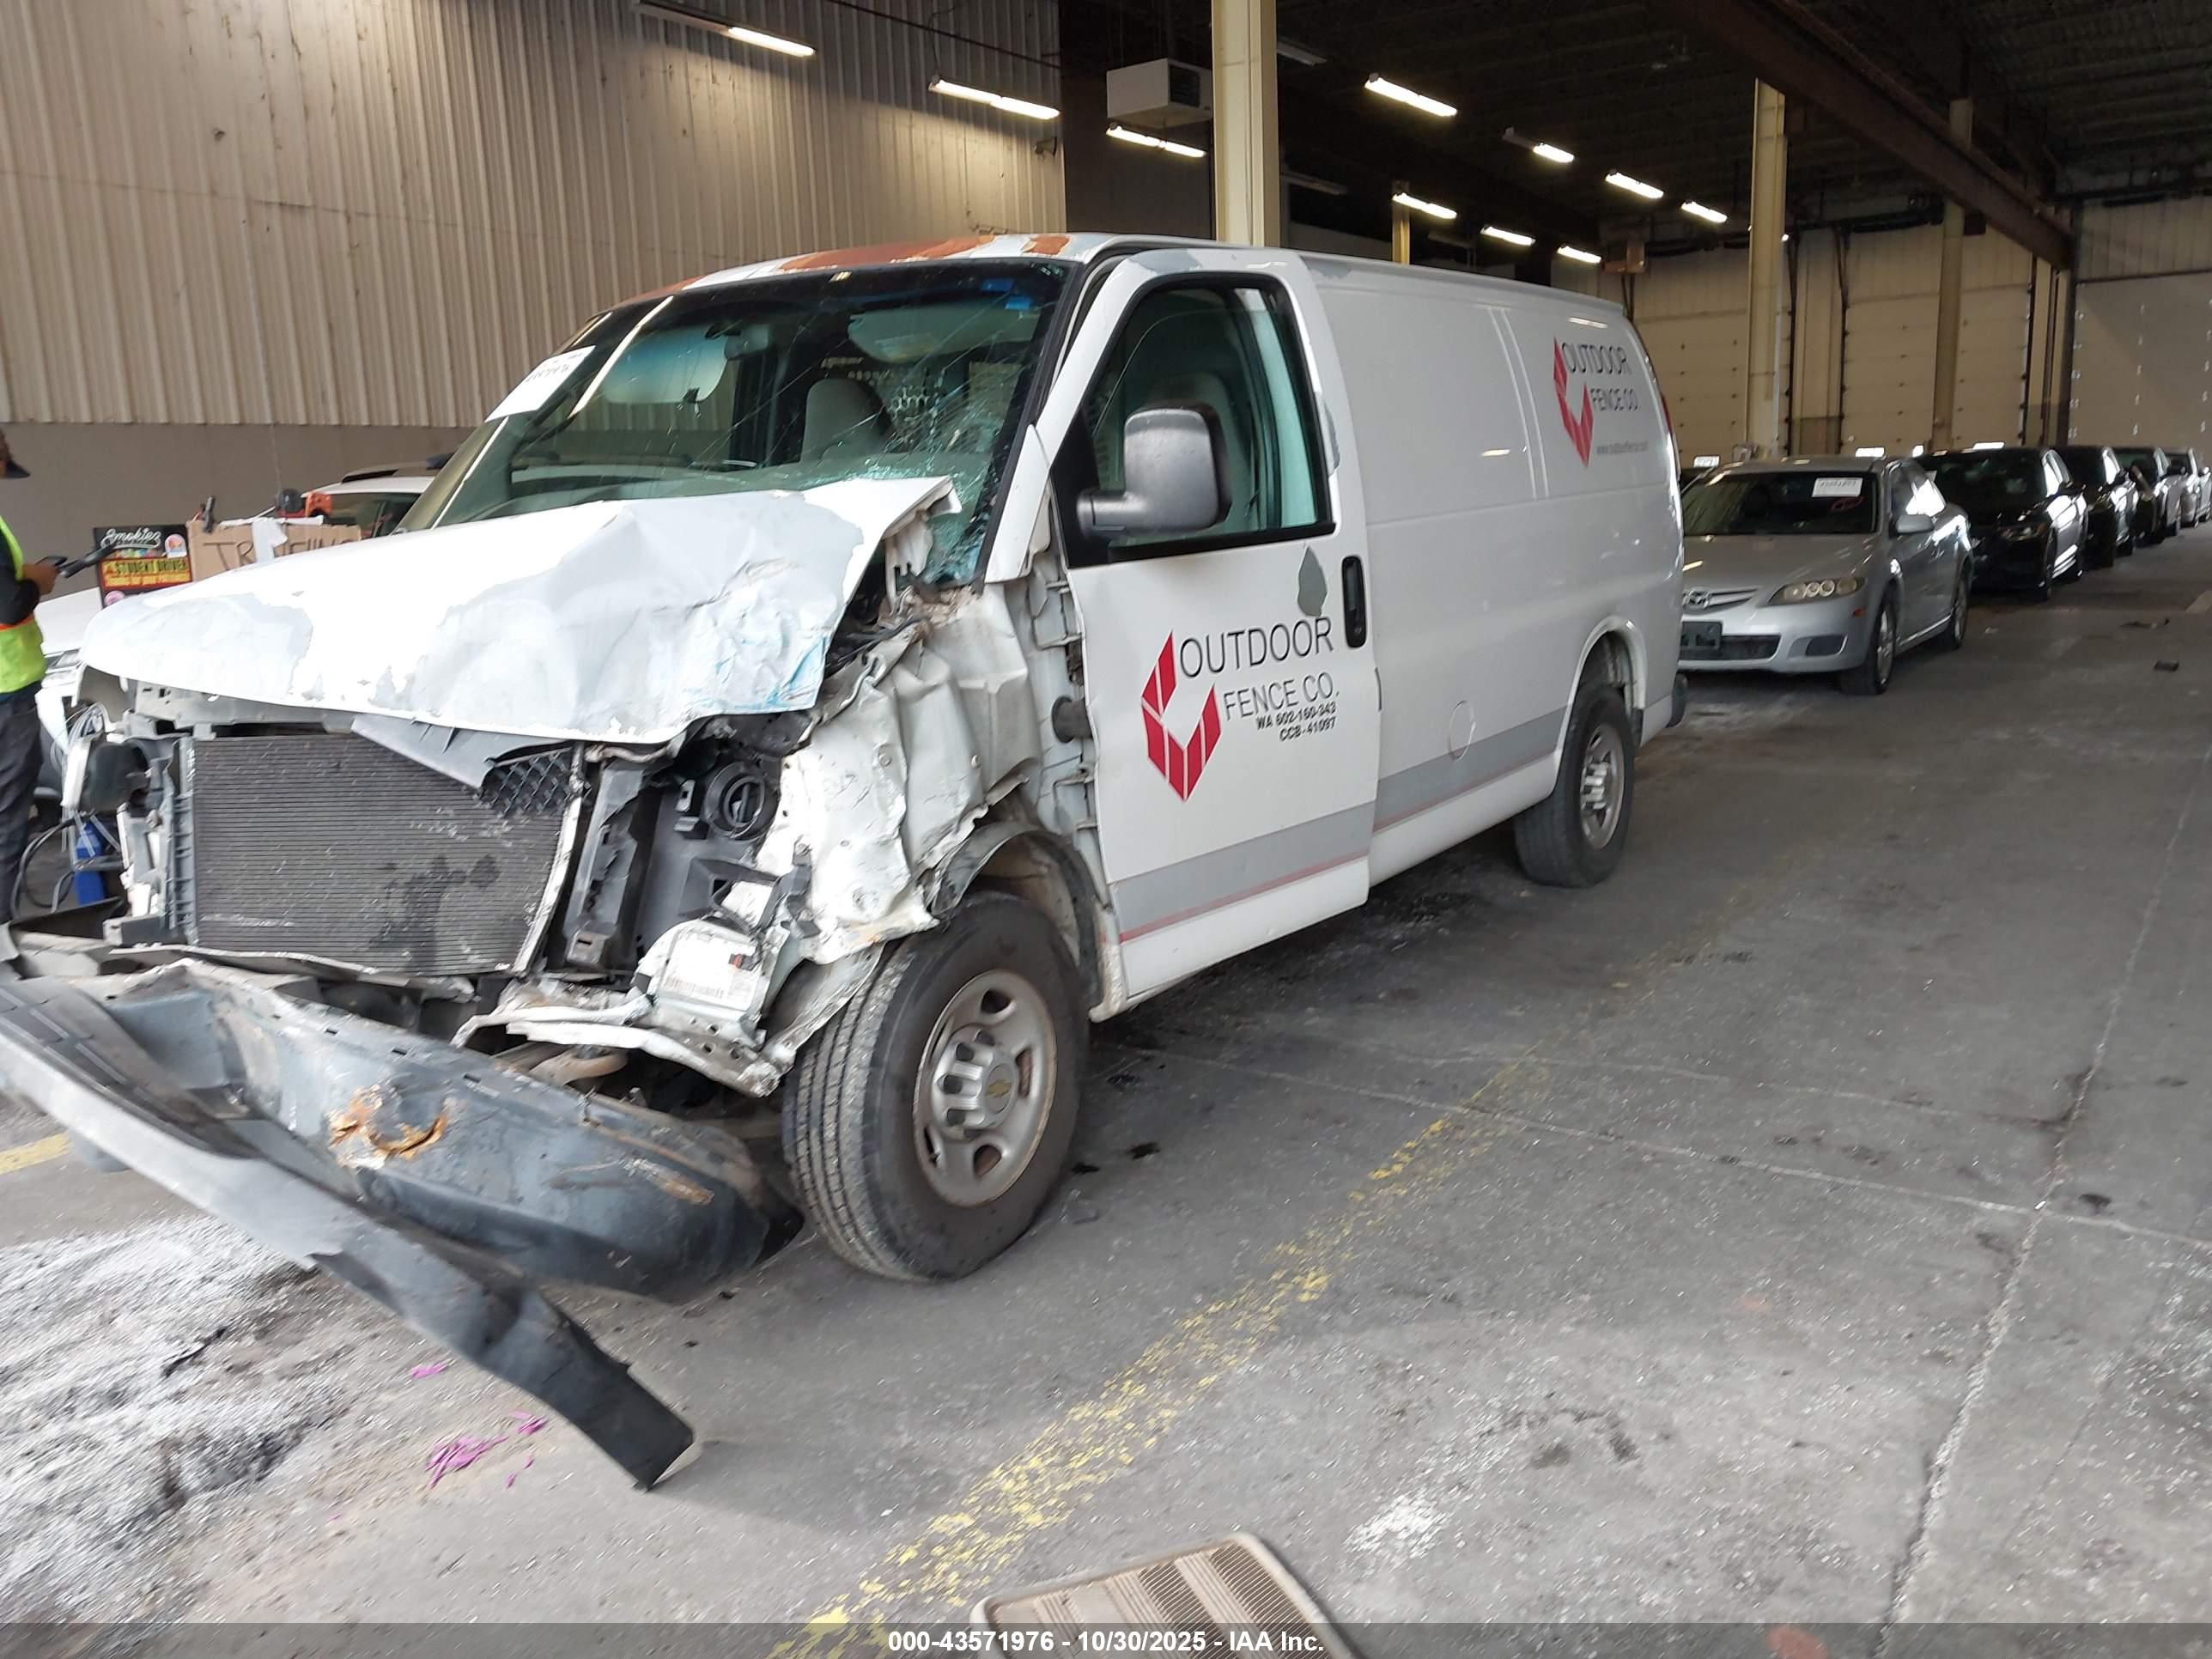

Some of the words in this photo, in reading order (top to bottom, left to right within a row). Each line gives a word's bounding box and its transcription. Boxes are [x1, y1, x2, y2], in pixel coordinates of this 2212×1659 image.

[1562, 343, 1632, 374] OUTDOOR
[1590, 388, 1625, 410] FENCE
[1180, 617, 1334, 678] OUTDOOR
[1223, 678, 1299, 721] FENCE
[1303, 672, 1340, 702] CO.
[1256, 714, 1274, 731] WA
